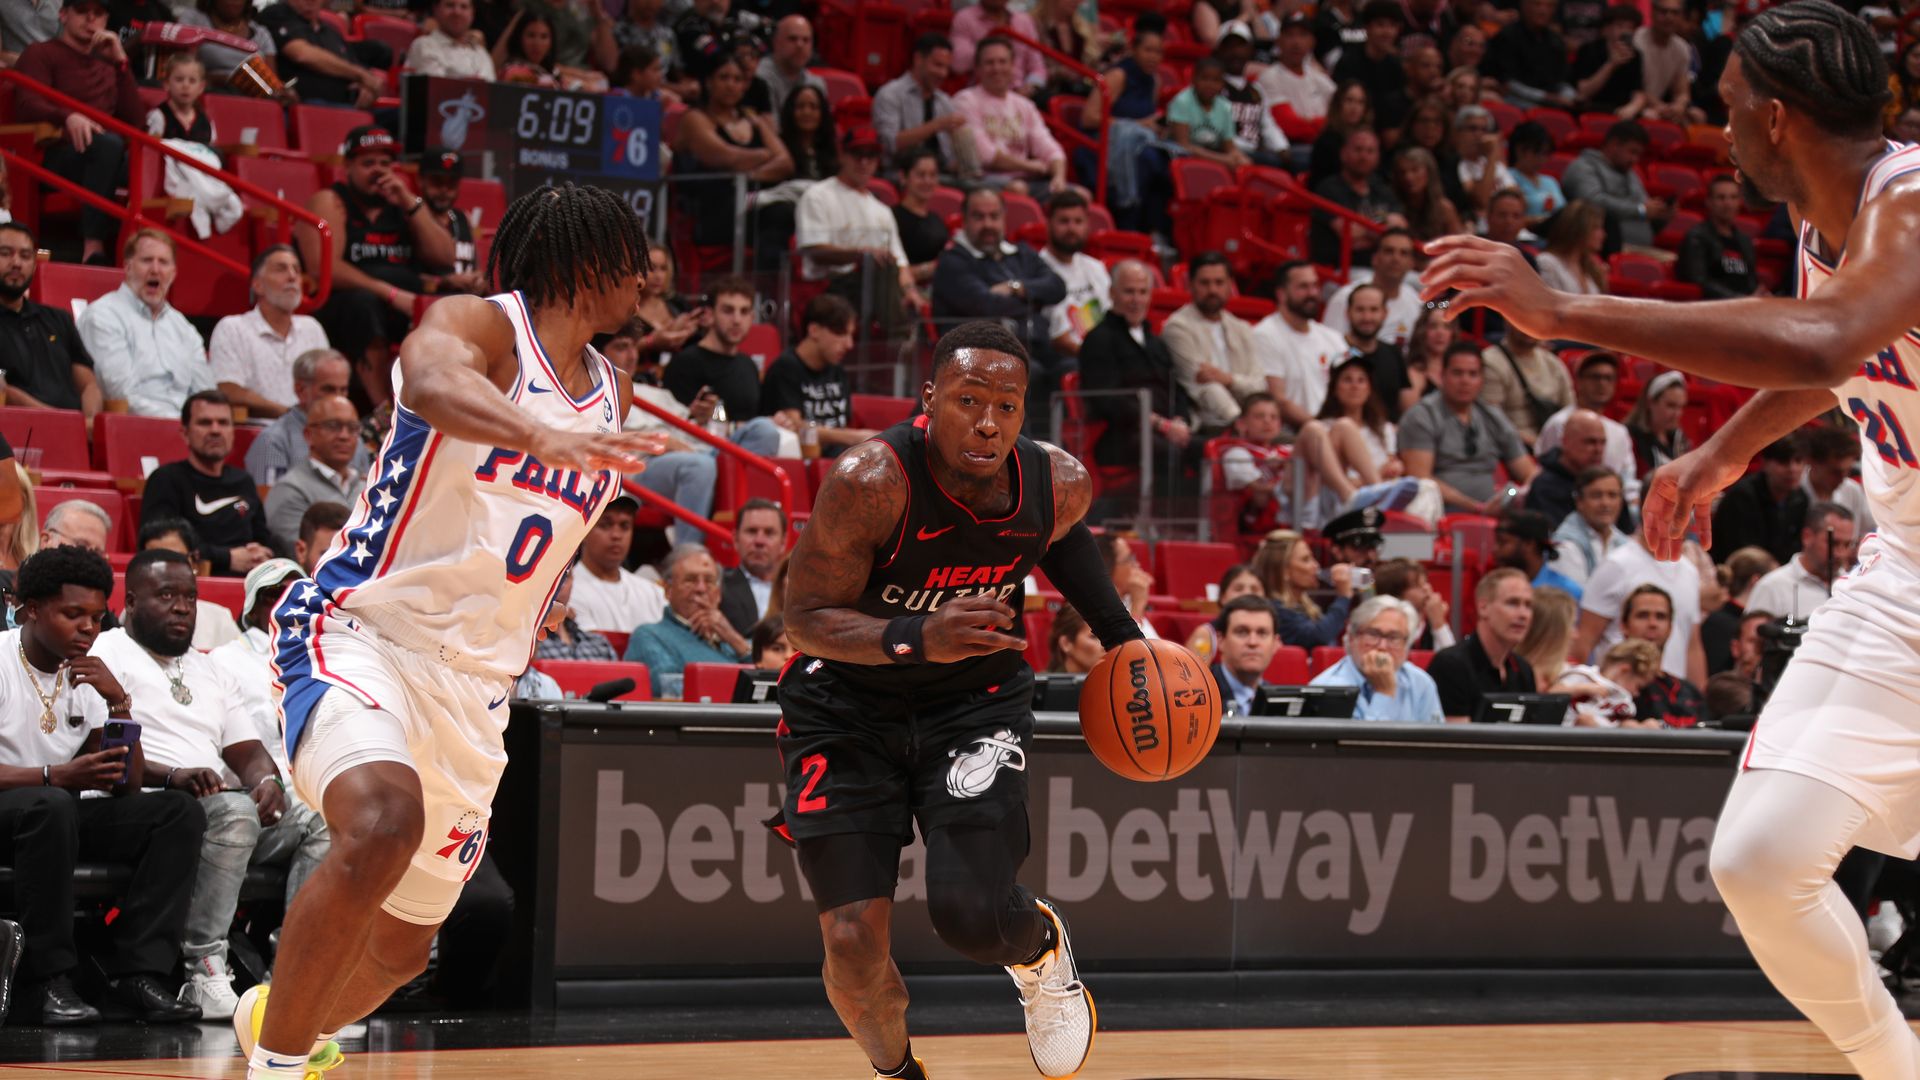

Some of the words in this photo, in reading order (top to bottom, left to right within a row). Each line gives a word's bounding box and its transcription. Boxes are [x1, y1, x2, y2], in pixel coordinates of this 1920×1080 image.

[517, 93, 596, 144] 6:09
[611, 127, 648, 167] 76
[519, 147, 569, 169] BONUS
[1847, 397, 1920, 470] 21
[505, 513, 553, 584] 0
[924, 554, 1022, 589] HEAT
[1126, 657, 1160, 754] Wilson
[797, 753, 828, 813] 2
[435, 825, 482, 865] 76
[594, 770, 928, 903] bet
[1046, 776, 1414, 935] betway
[1449, 783, 1738, 936] betwa
